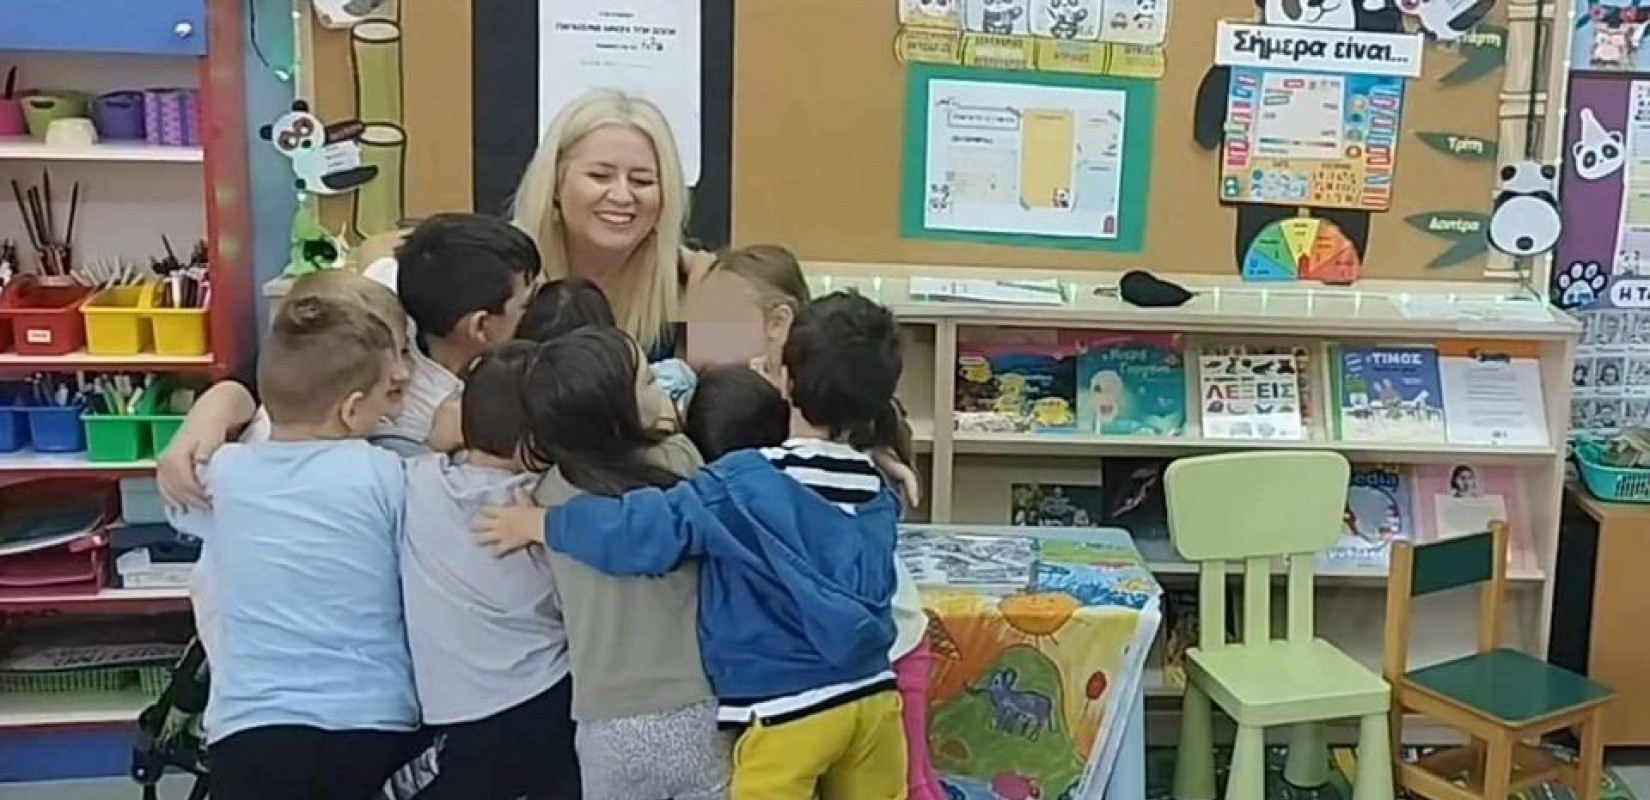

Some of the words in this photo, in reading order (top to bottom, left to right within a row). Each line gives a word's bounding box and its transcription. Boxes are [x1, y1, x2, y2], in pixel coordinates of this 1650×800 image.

[1233, 30, 1326, 61] Σήμερα
[1334, 37, 1409, 63] είναι...
[1207, 382, 1295, 400] ΛΕΞΕΙΣ
